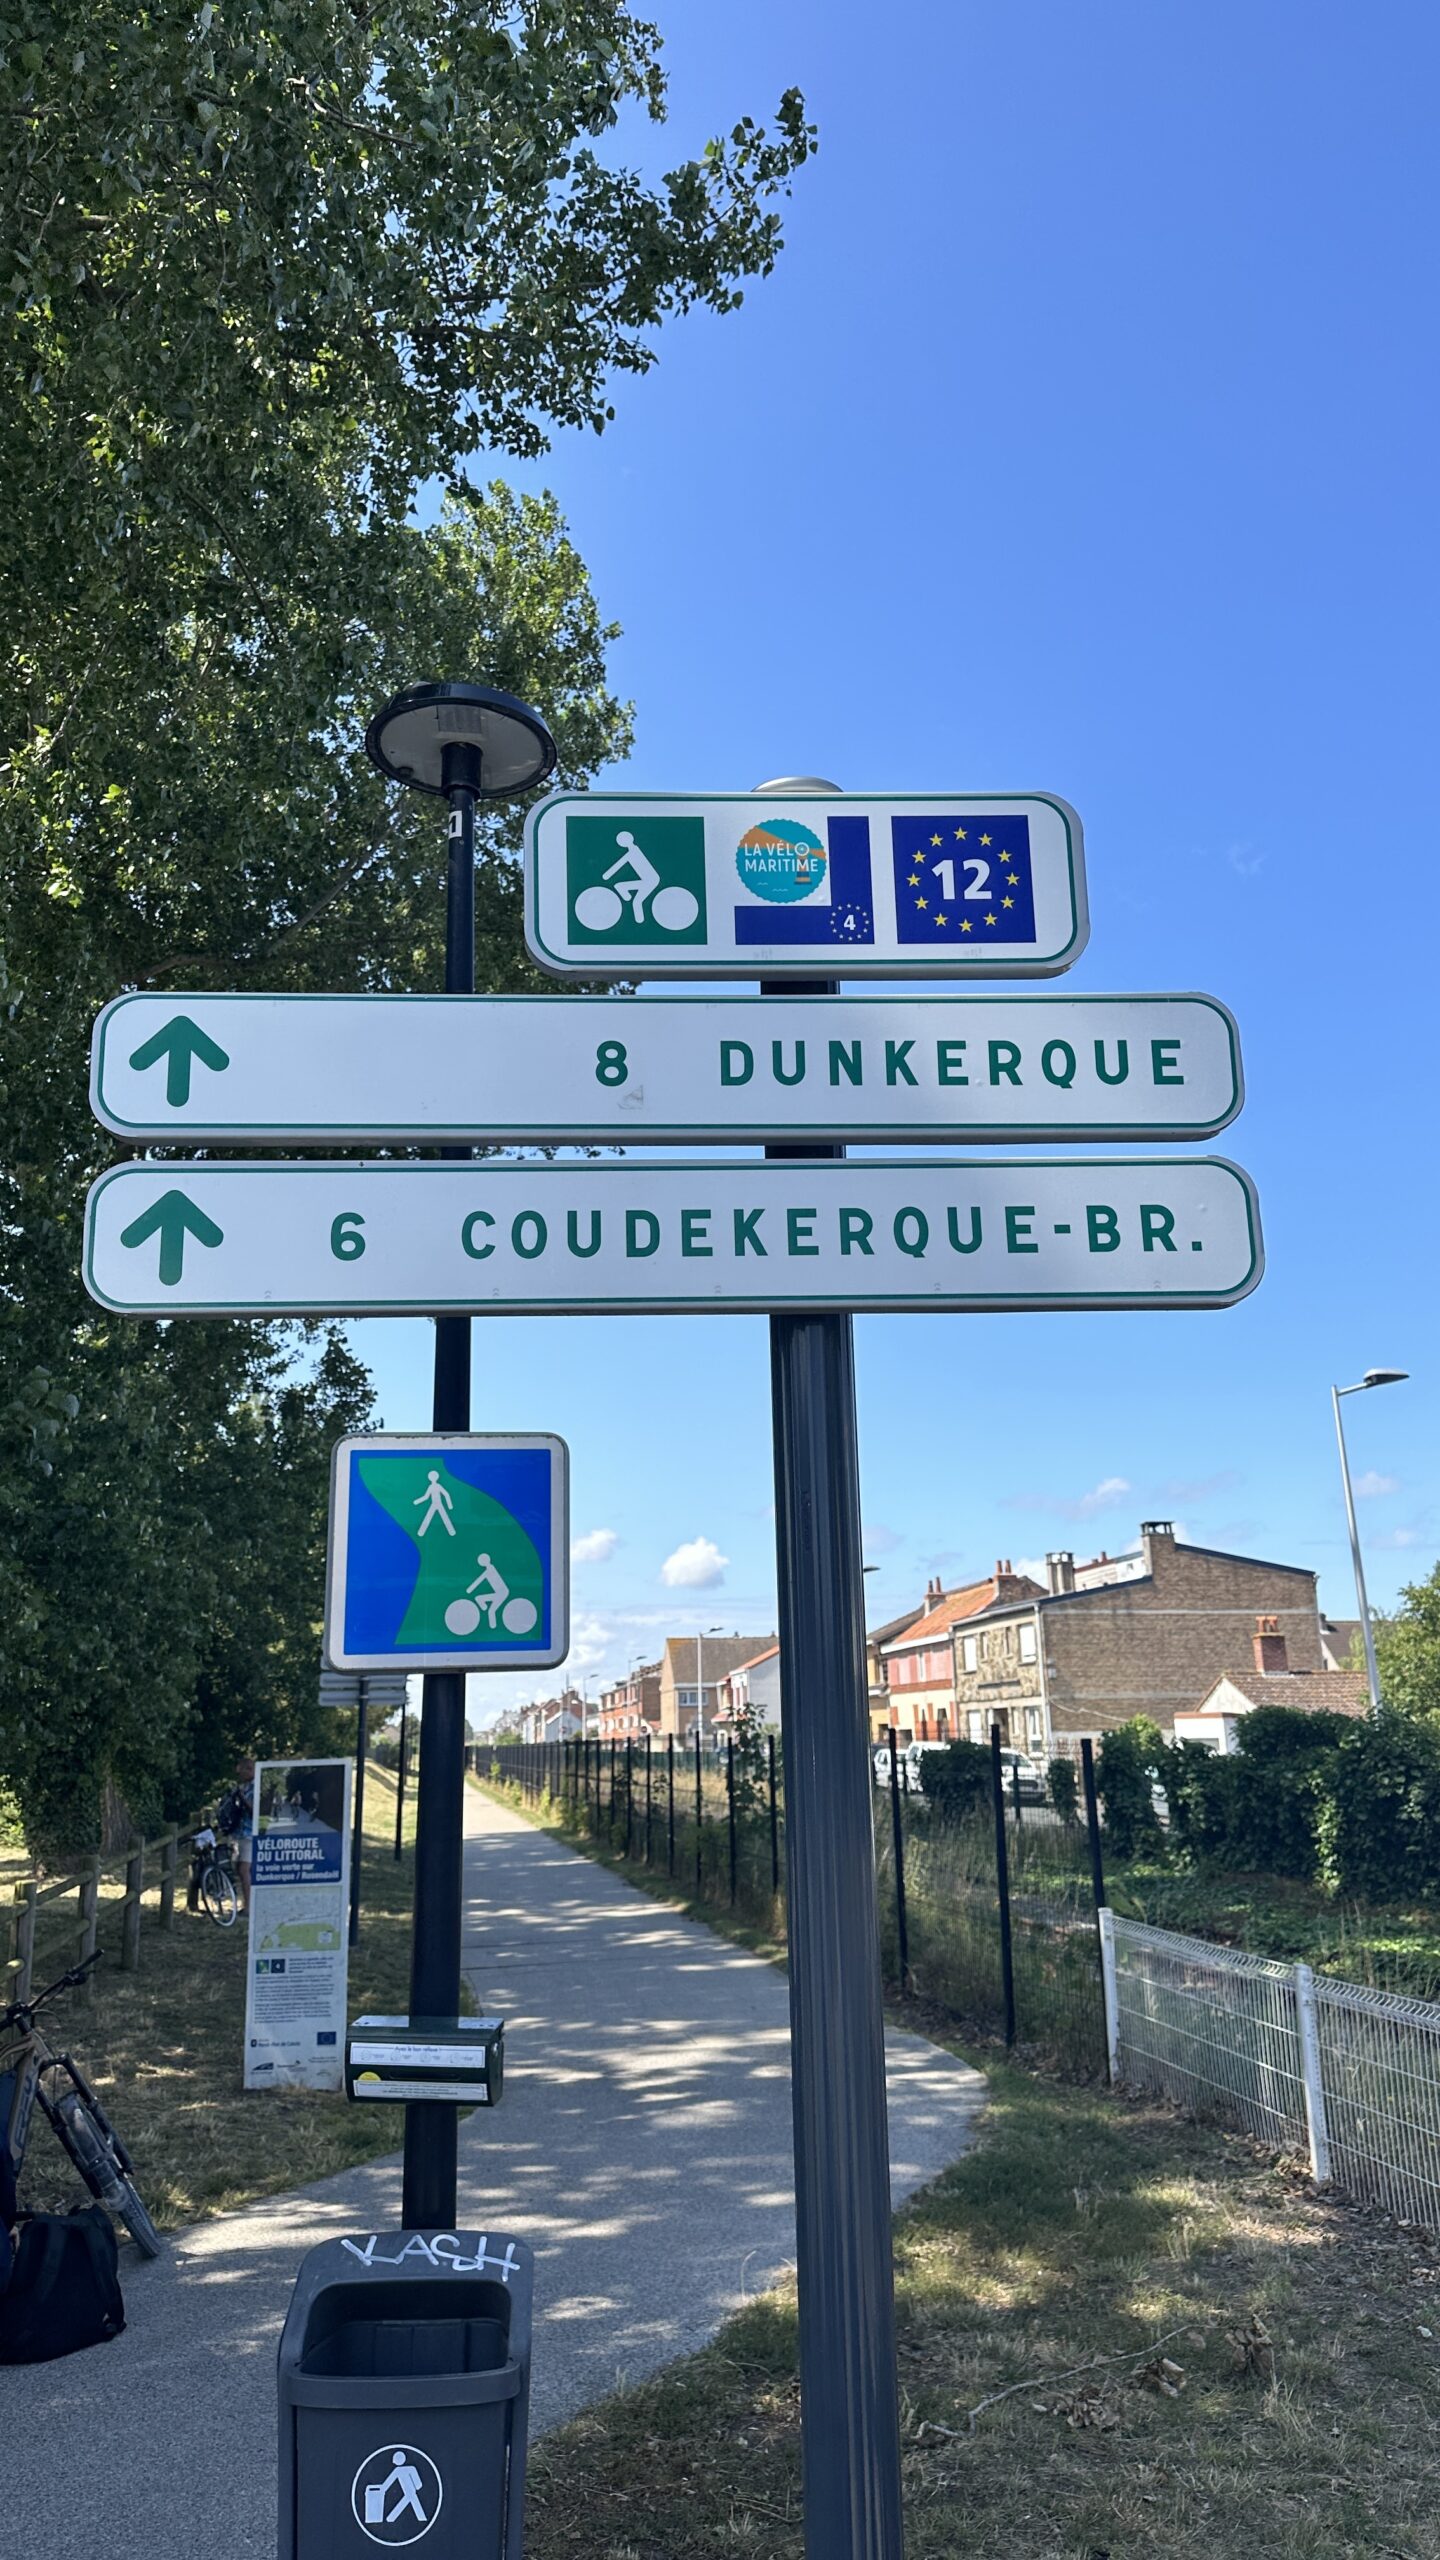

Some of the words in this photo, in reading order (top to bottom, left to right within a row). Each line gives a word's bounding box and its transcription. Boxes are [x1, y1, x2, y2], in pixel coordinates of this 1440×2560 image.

[744, 842, 762, 856] LA
[765, 839, 810, 857] VÉLO
[744, 858, 819, 872] MARITIME
[931, 858, 993, 900] 12
[843, 914, 856, 931] 4
[595, 1040, 629, 1087] 8
[719, 1039, 1185, 1089] DUNKERQUE
[330, 1212, 366, 1261] 6
[461, 1205, 1203, 1260] COUDEKERQUE-BR.
[257, 1837, 319, 1850] VÉLOROUTE
[257, 1850, 272, 1862] DU
[274, 1848, 325, 1861] LITTORAL
[265, 1864, 280, 1872] voie
[282, 1863, 300, 1871] verte
[256, 1872, 295, 1882] Dunkerque
